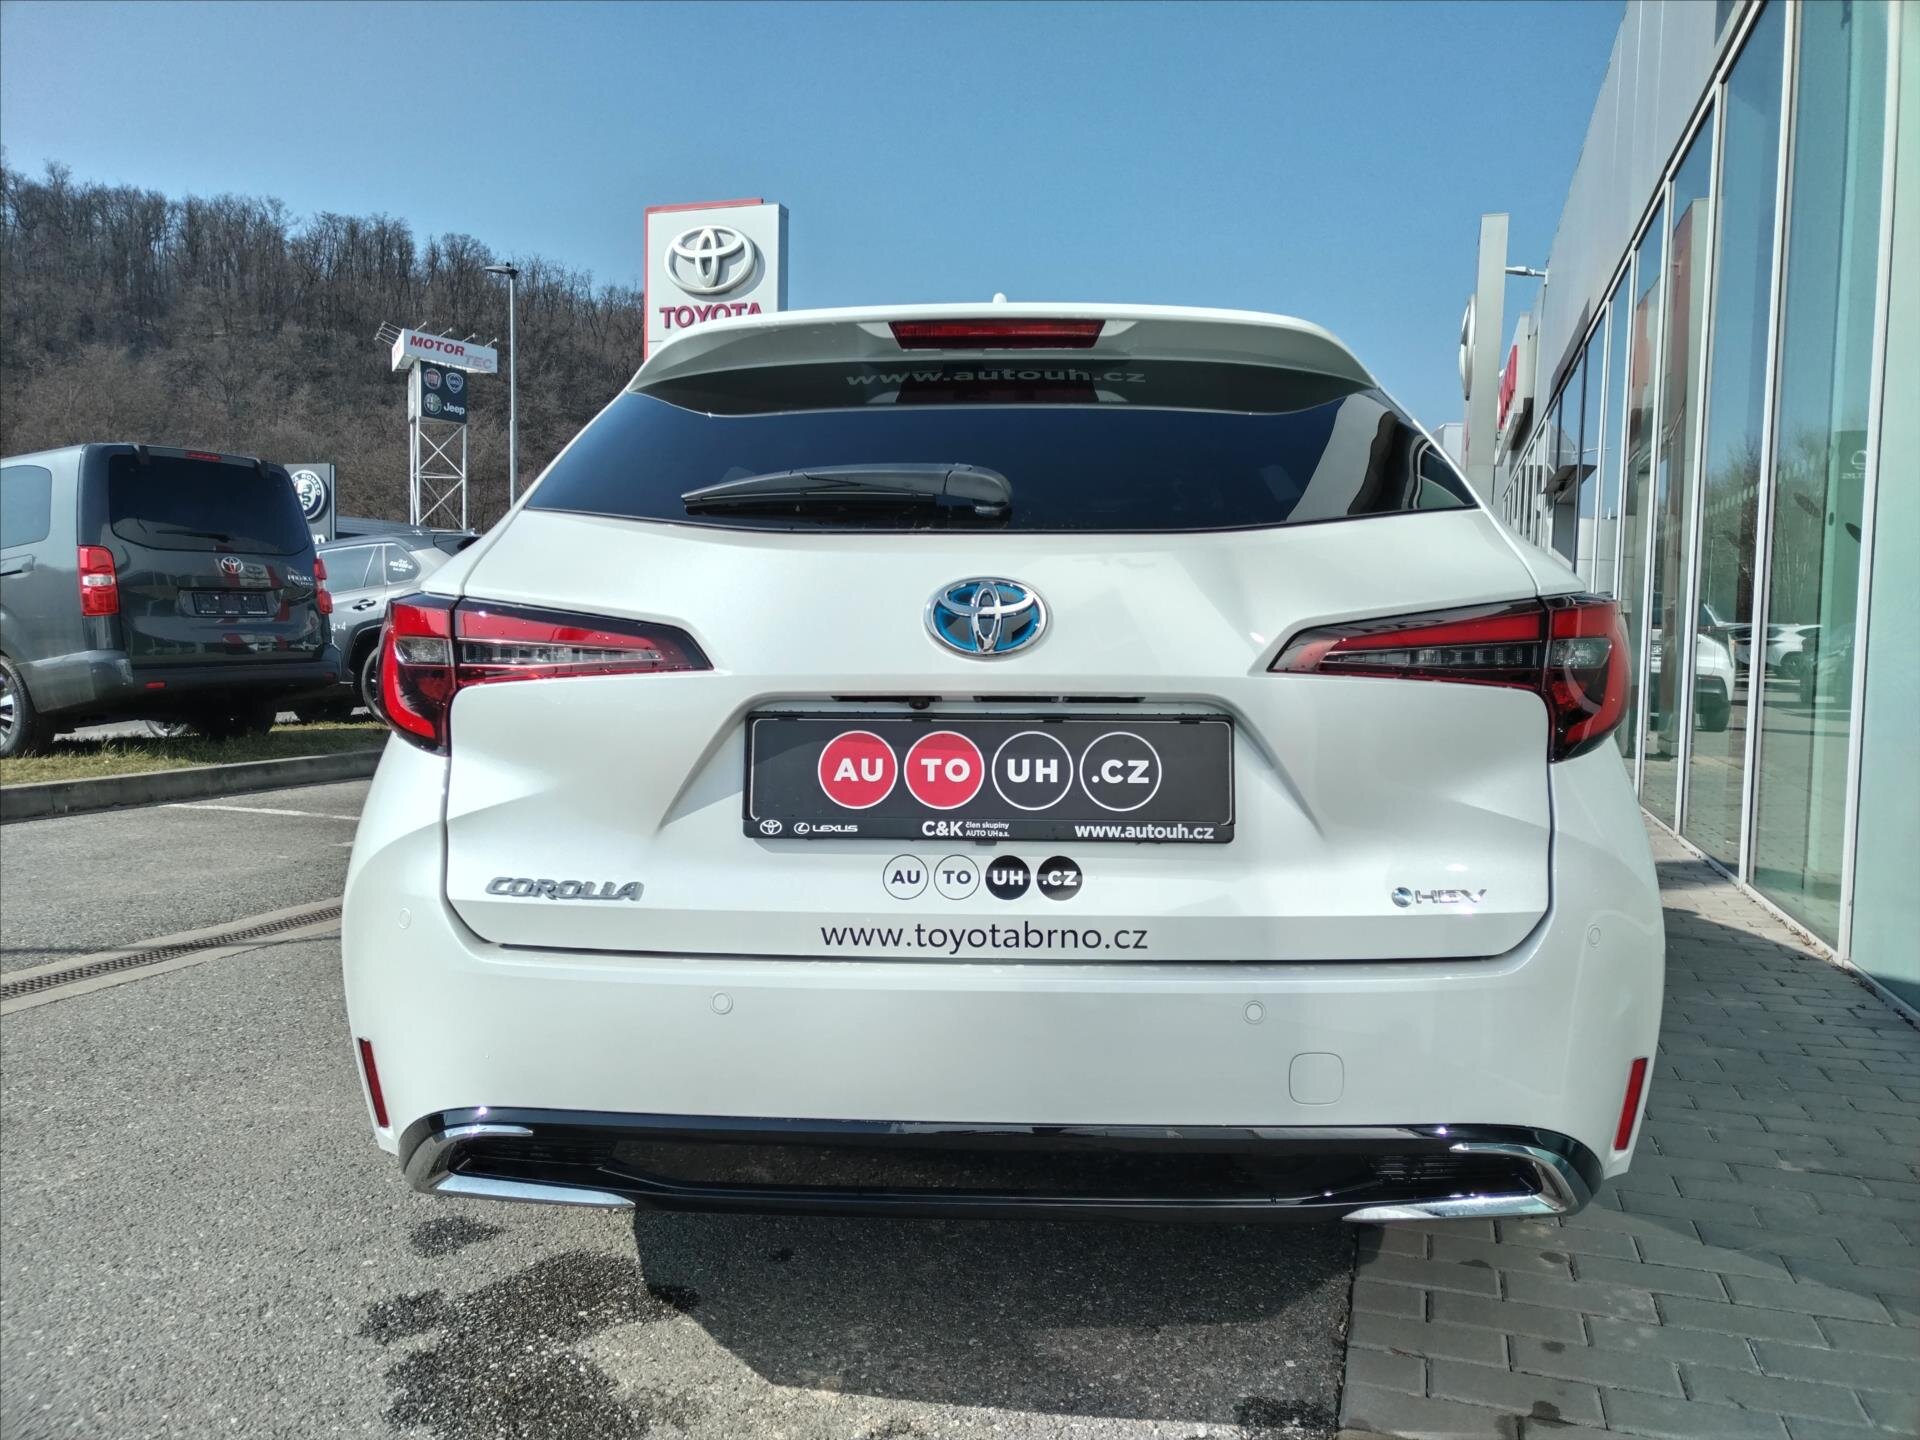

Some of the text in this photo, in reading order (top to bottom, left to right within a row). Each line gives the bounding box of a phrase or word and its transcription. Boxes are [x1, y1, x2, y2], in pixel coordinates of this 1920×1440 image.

[659, 303, 762, 329] TOYOTA
[410, 335, 465, 357] MOTOR
[465, 354, 493, 370] TEC
[846, 368, 1147, 386] www.autouh.cz
[443, 402, 465, 415] Jeep
[833, 757, 1149, 784] AU TO UH .CZ
[812, 824, 858, 833] LEXUS
[922, 820, 963, 837] C&K
[965, 821, 1010, 830] člen skupiny
[965, 829, 986, 837] AUTO
[987, 829, 998, 837] UH
[1074, 823, 1215, 840] www.autouh.cz
[891, 869, 1078, 886] AU TO UH .CZ
[485, 876, 645, 902] COROLLA
[1415, 888, 1487, 904] HEV
[820, 920, 1149, 956] www.toyotabrno.cz
